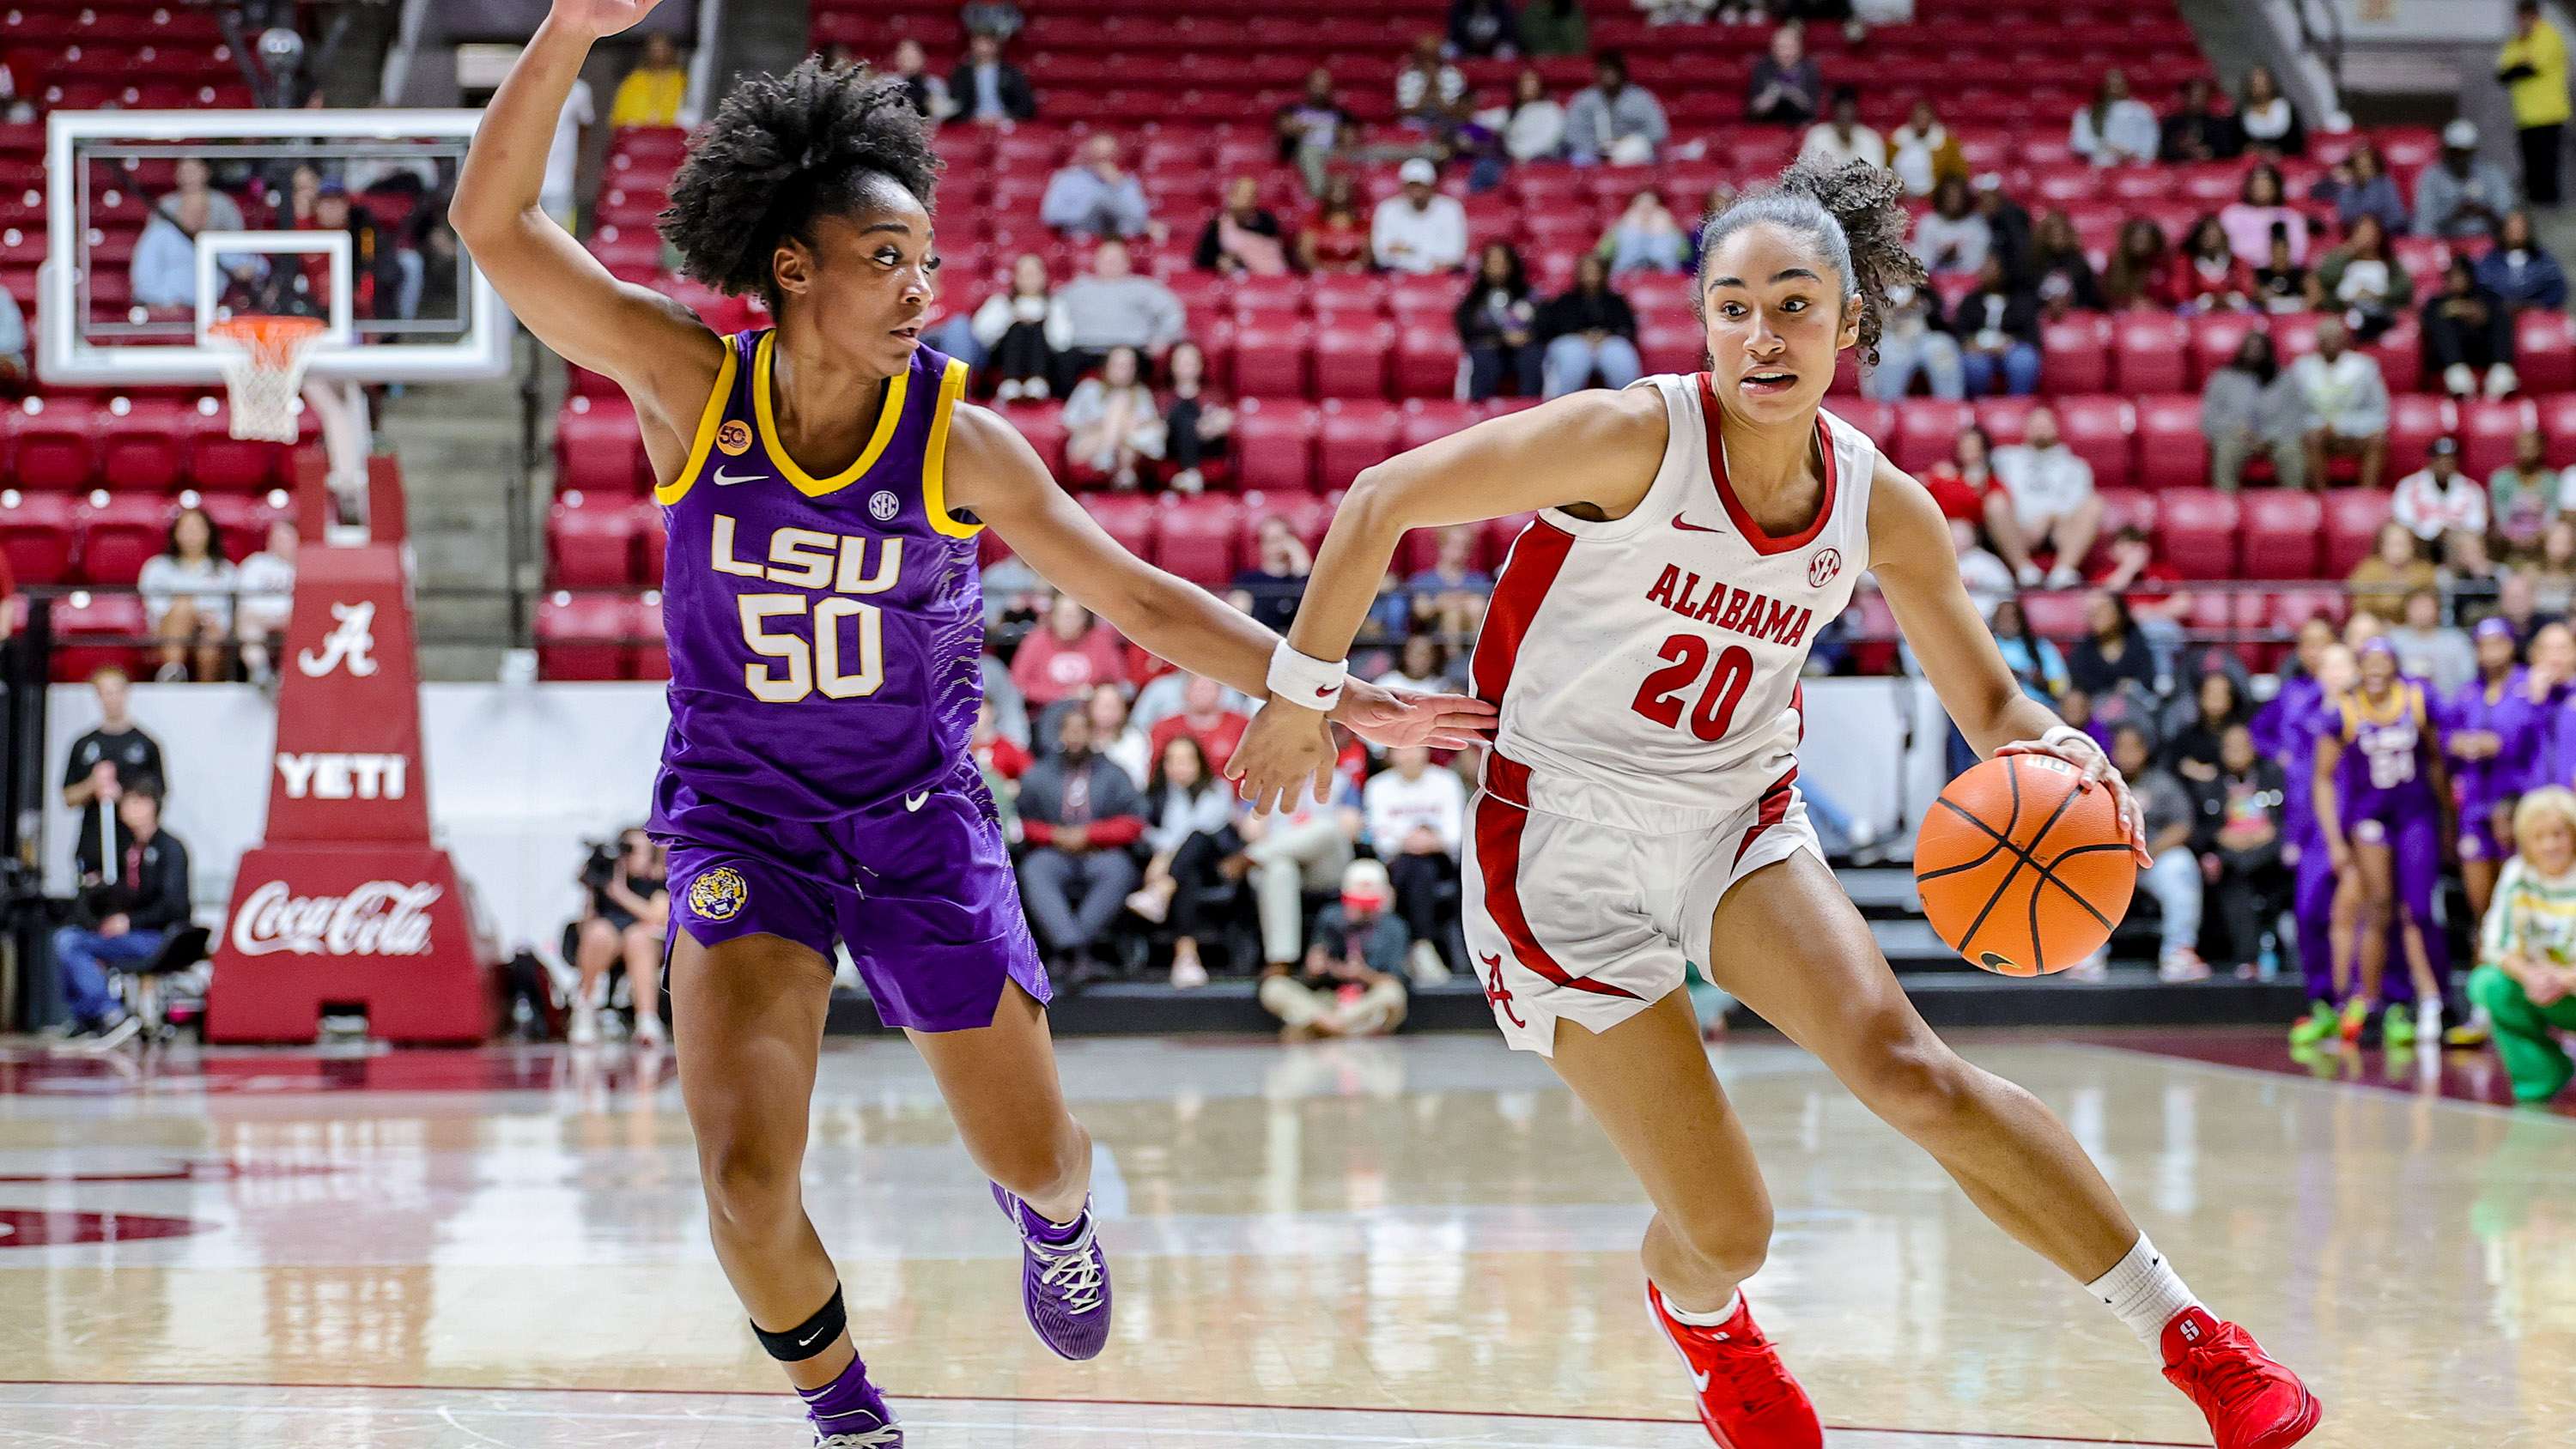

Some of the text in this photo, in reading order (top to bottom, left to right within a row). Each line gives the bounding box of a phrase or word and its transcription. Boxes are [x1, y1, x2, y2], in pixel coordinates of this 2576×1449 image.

[871, 493, 897, 518] SEC
[711, 513, 904, 594] LSU
[1810, 549, 1840, 586] SEC
[297, 600, 378, 677] A
[1645, 562, 1813, 647] ALABAMA
[737, 593, 884, 703] 50
[1631, 634, 1754, 742] 20
[276, 751, 406, 800] YETI
